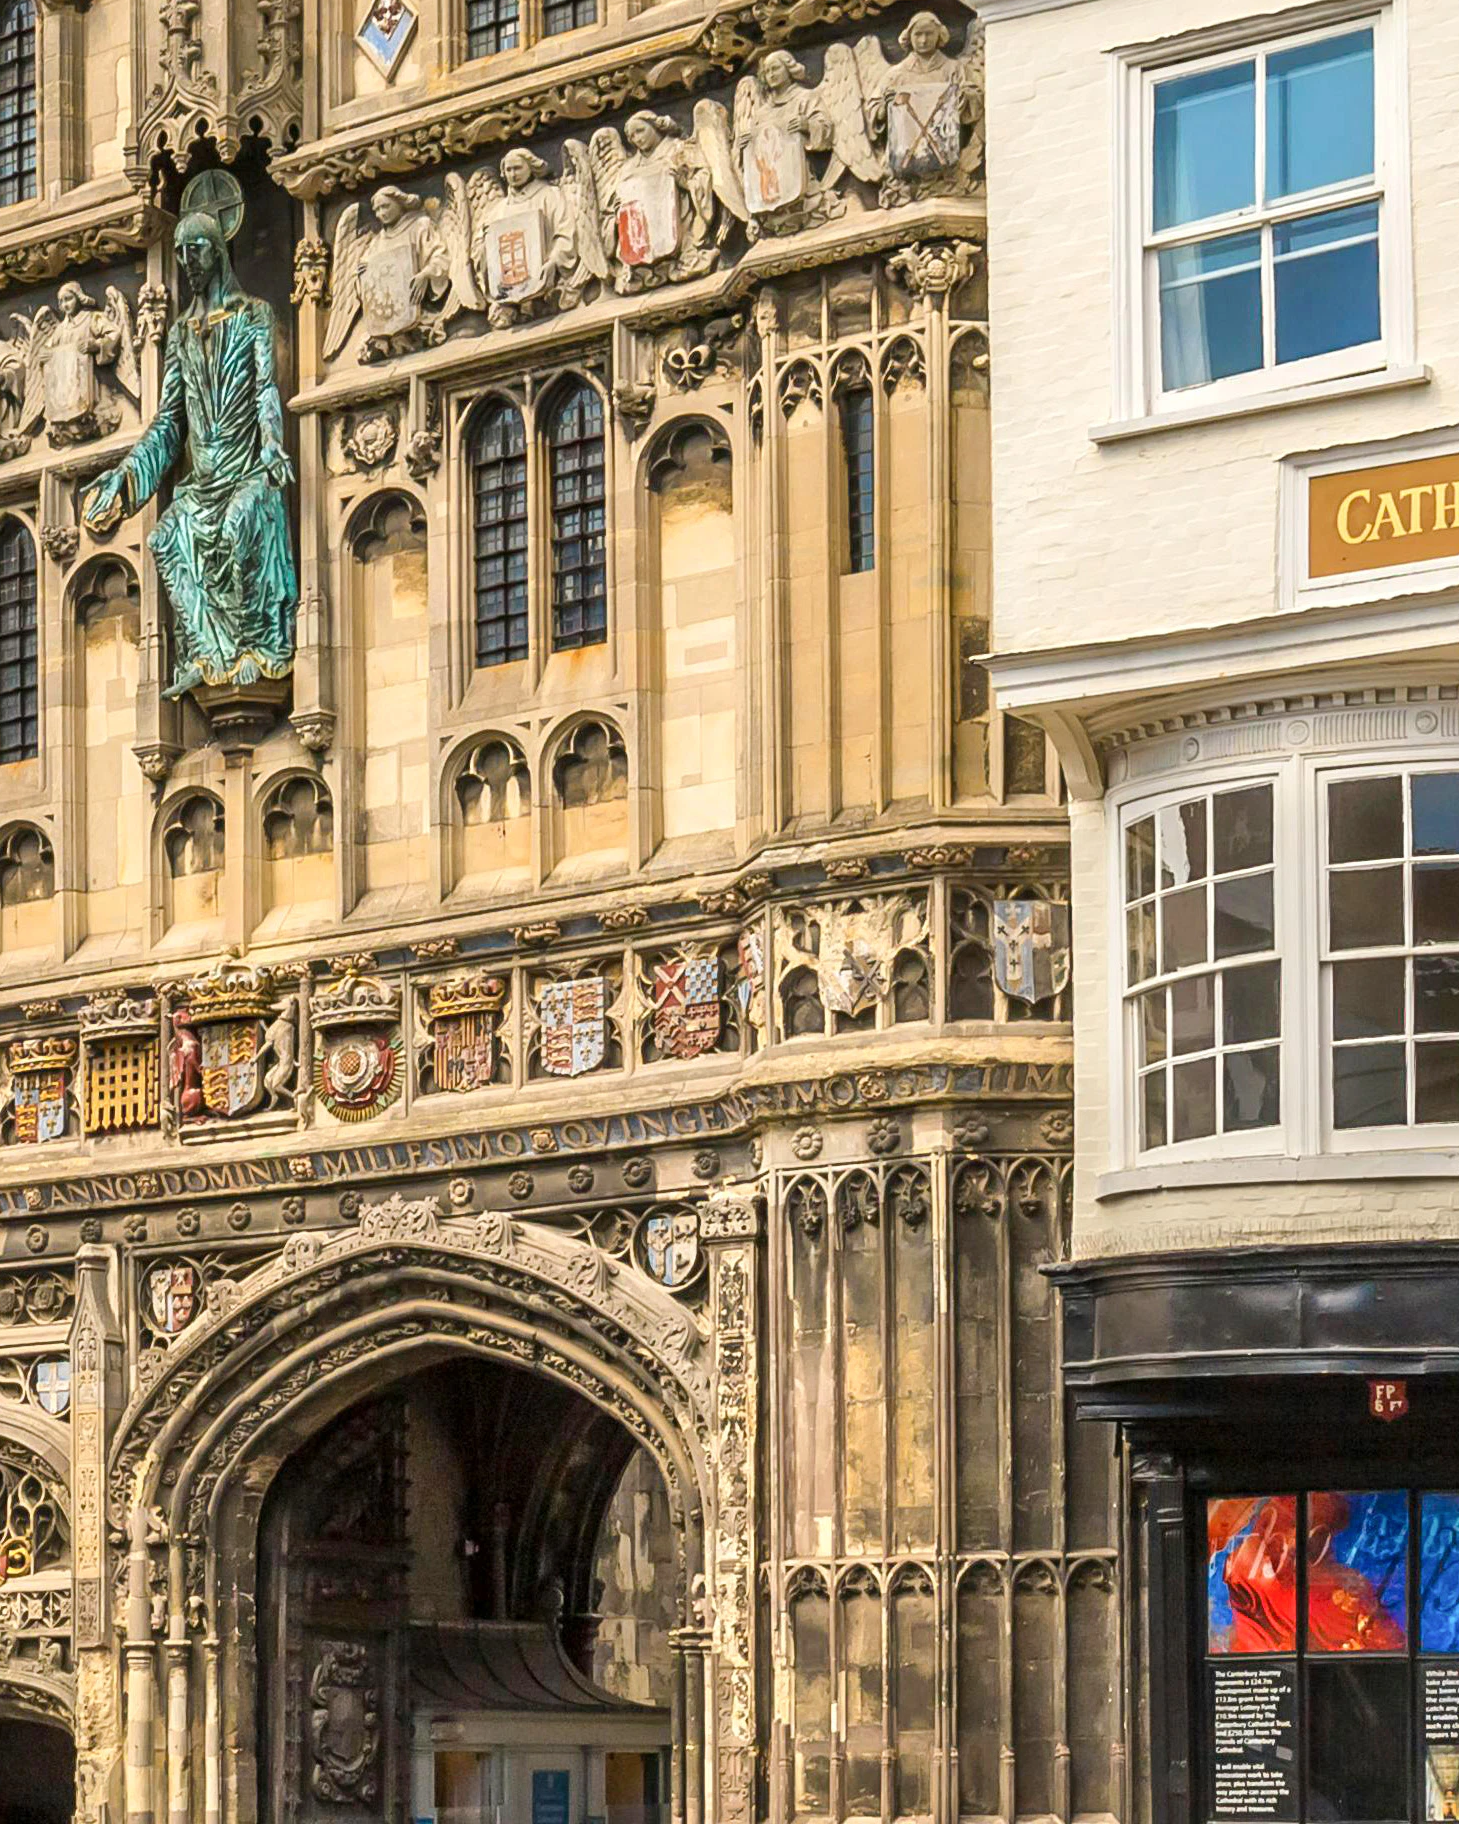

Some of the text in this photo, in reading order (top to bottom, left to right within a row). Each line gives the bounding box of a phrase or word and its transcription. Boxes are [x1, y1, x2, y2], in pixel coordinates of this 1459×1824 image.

[50, 1176, 136, 1207] ANNO
[160, 1159, 283, 1196] DOMINI
[1376, 1385, 1395, 1399] FP
[1375, 1399, 1383, 1412] 6
